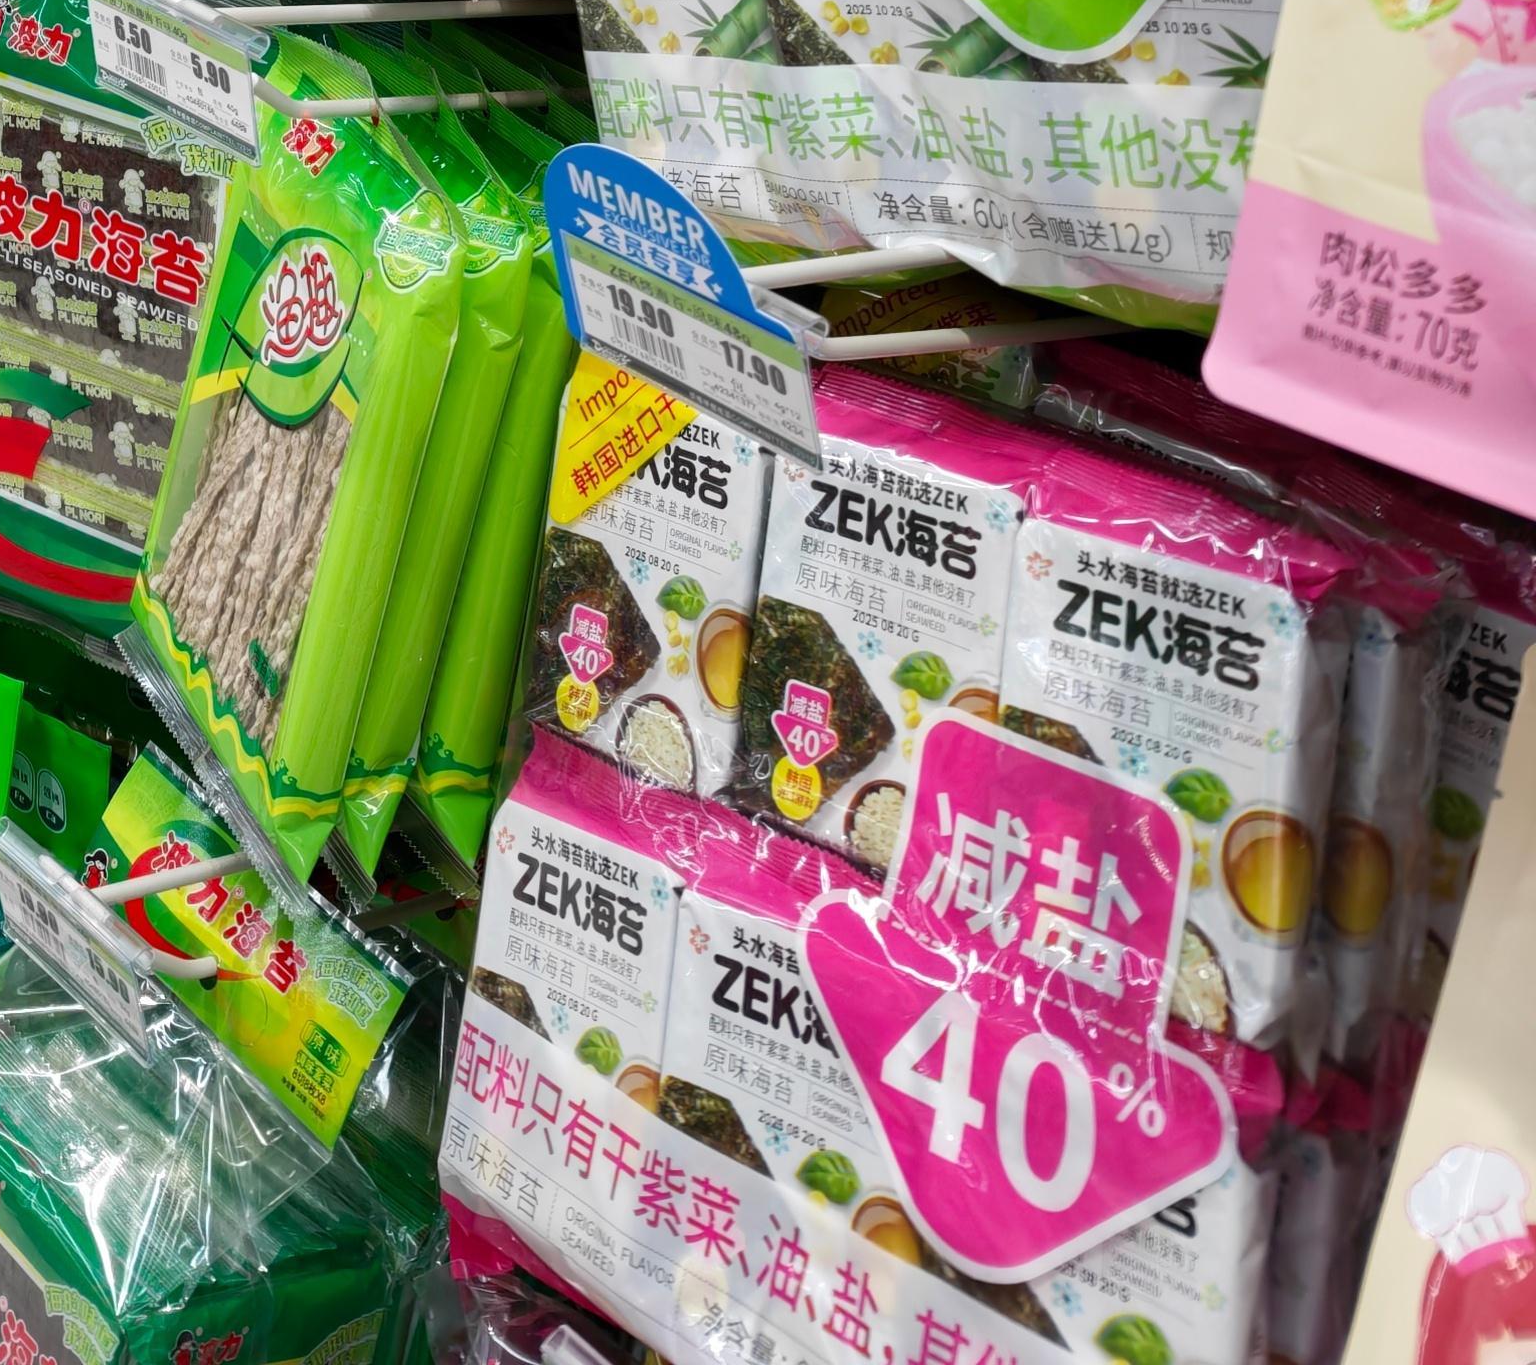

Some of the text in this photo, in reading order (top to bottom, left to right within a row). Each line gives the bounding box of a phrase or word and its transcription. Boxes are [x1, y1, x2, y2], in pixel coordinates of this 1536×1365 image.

[8, 17, 76, 68] 波力
[114, 15, 153, 55] 6.50
[190, 51, 232, 95] 5.90
[566, 160, 712, 257] MEMBER
[21, 257, 200, 332] SEASONED SEAWEED
[1319, 230, 1489, 316] 肉松多多
[607, 282, 788, 396] 19.90 17.90
[1308, 275, 1480, 373] 净含量:70克
[828, 453, 970, 516] 头水海苔就选ZEK
[804, 479, 983, 581] ZEK海苔
[795, 561, 889, 616] 原味海苔
[852, 608, 879, 629] 2025
[1076, 550, 1247, 620] 头水海苔就选ZEK
[1052, 578, 1267, 691] ZEK海苔
[788, 692, 827, 728] 减盐
[780, 768, 816, 792] 韩国
[530, 825, 640, 892] 头水海苔就选ZEK
[512, 851, 649, 957] ZEK海苔
[915, 792, 1143, 1002] 减盐
[504, 934, 577, 990] 原味海苔
[305, 1027, 345, 1068] 原味
[703, 1043, 796, 1106] 原味海苔
[881, 989, 1166, 1214] 40%
[442, 1116, 545, 1223] 原味海苔
